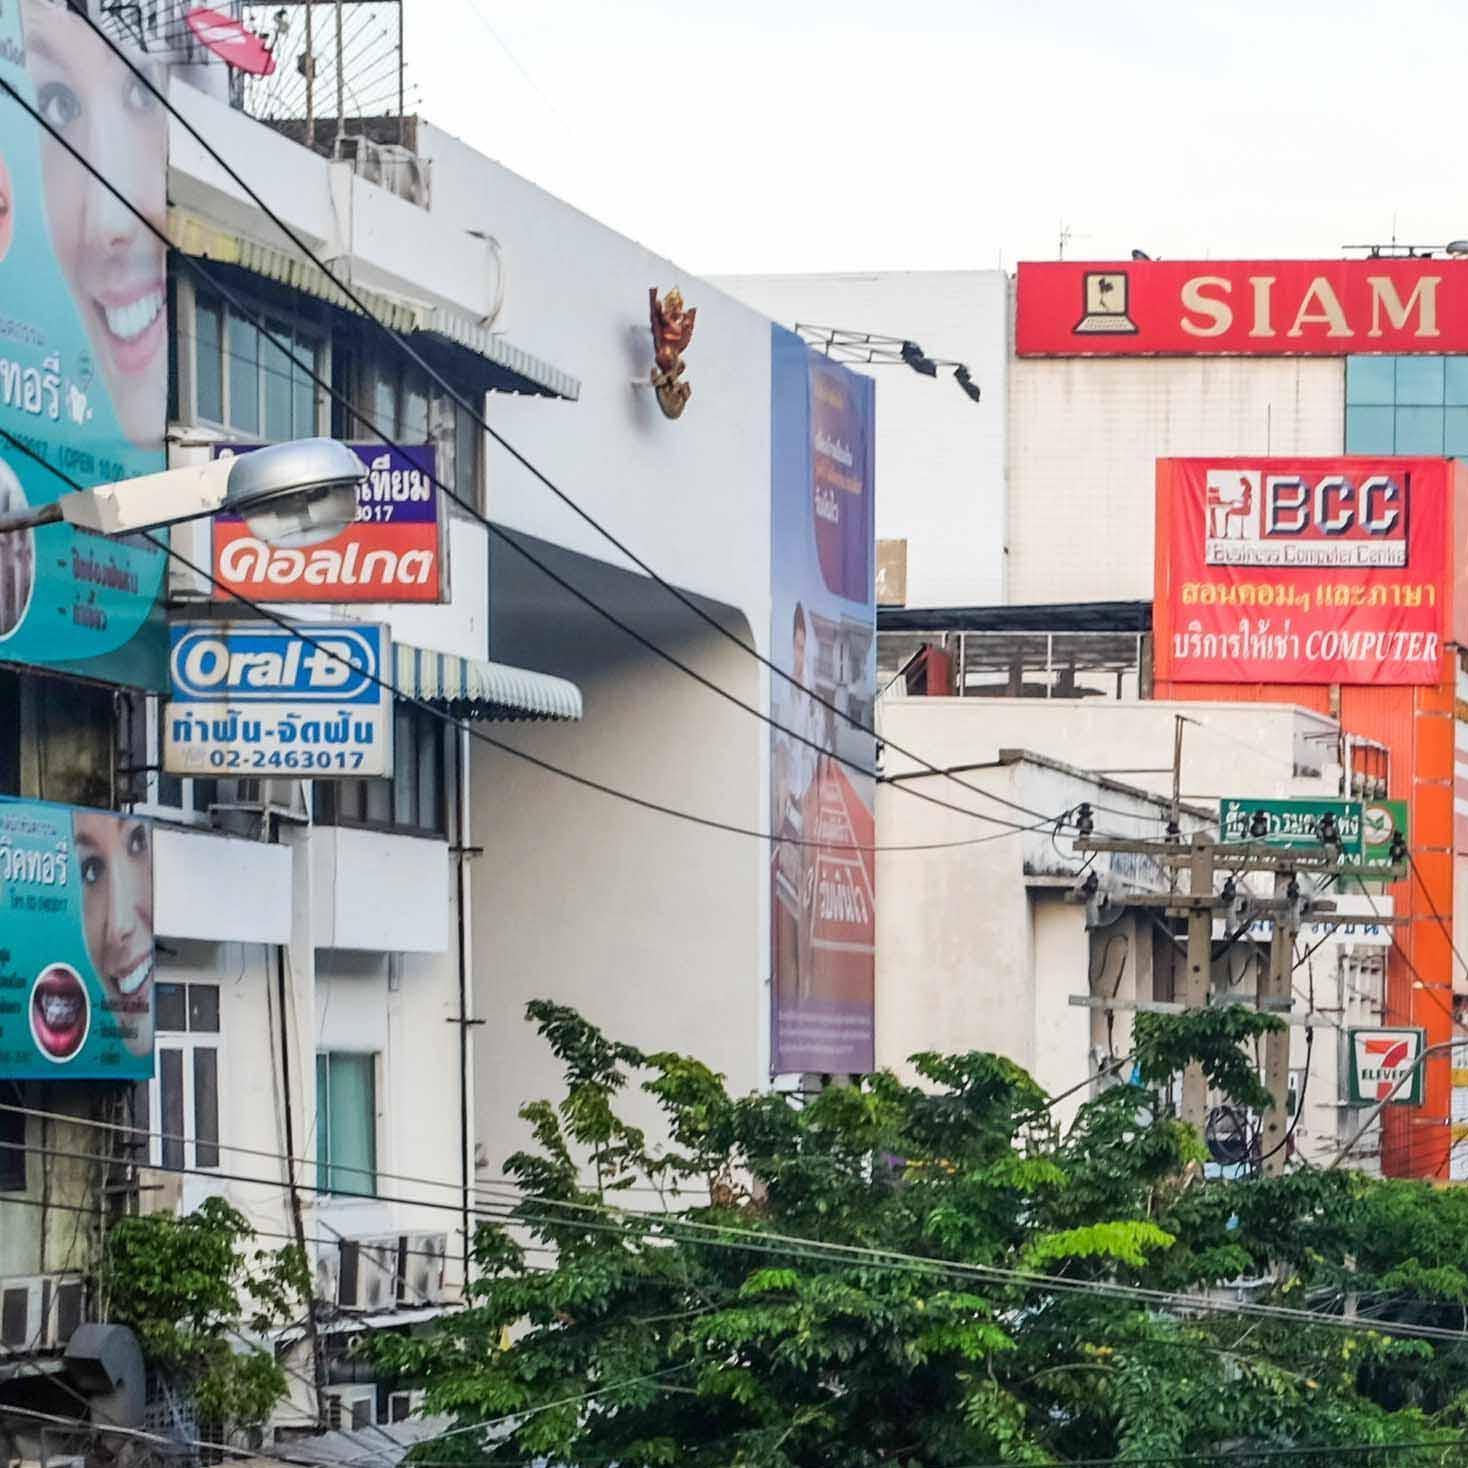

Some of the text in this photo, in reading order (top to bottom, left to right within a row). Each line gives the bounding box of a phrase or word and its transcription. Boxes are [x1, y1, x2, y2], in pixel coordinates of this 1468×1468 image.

[1180, 275, 1443, 338] SIAM
[1266, 475, 1403, 535] BCC
[1284, 545, 1352, 566] Computer
[1173, 617, 1438, 662] บริการให้เช่า COMPUTER
[185, 640, 353, 688] Oral-B
[172, 709, 374, 745] ทำฟัน-จัดฟัน
[209, 751, 365, 769] 02-2463017
[1365, 1039, 1409, 1102] 7
